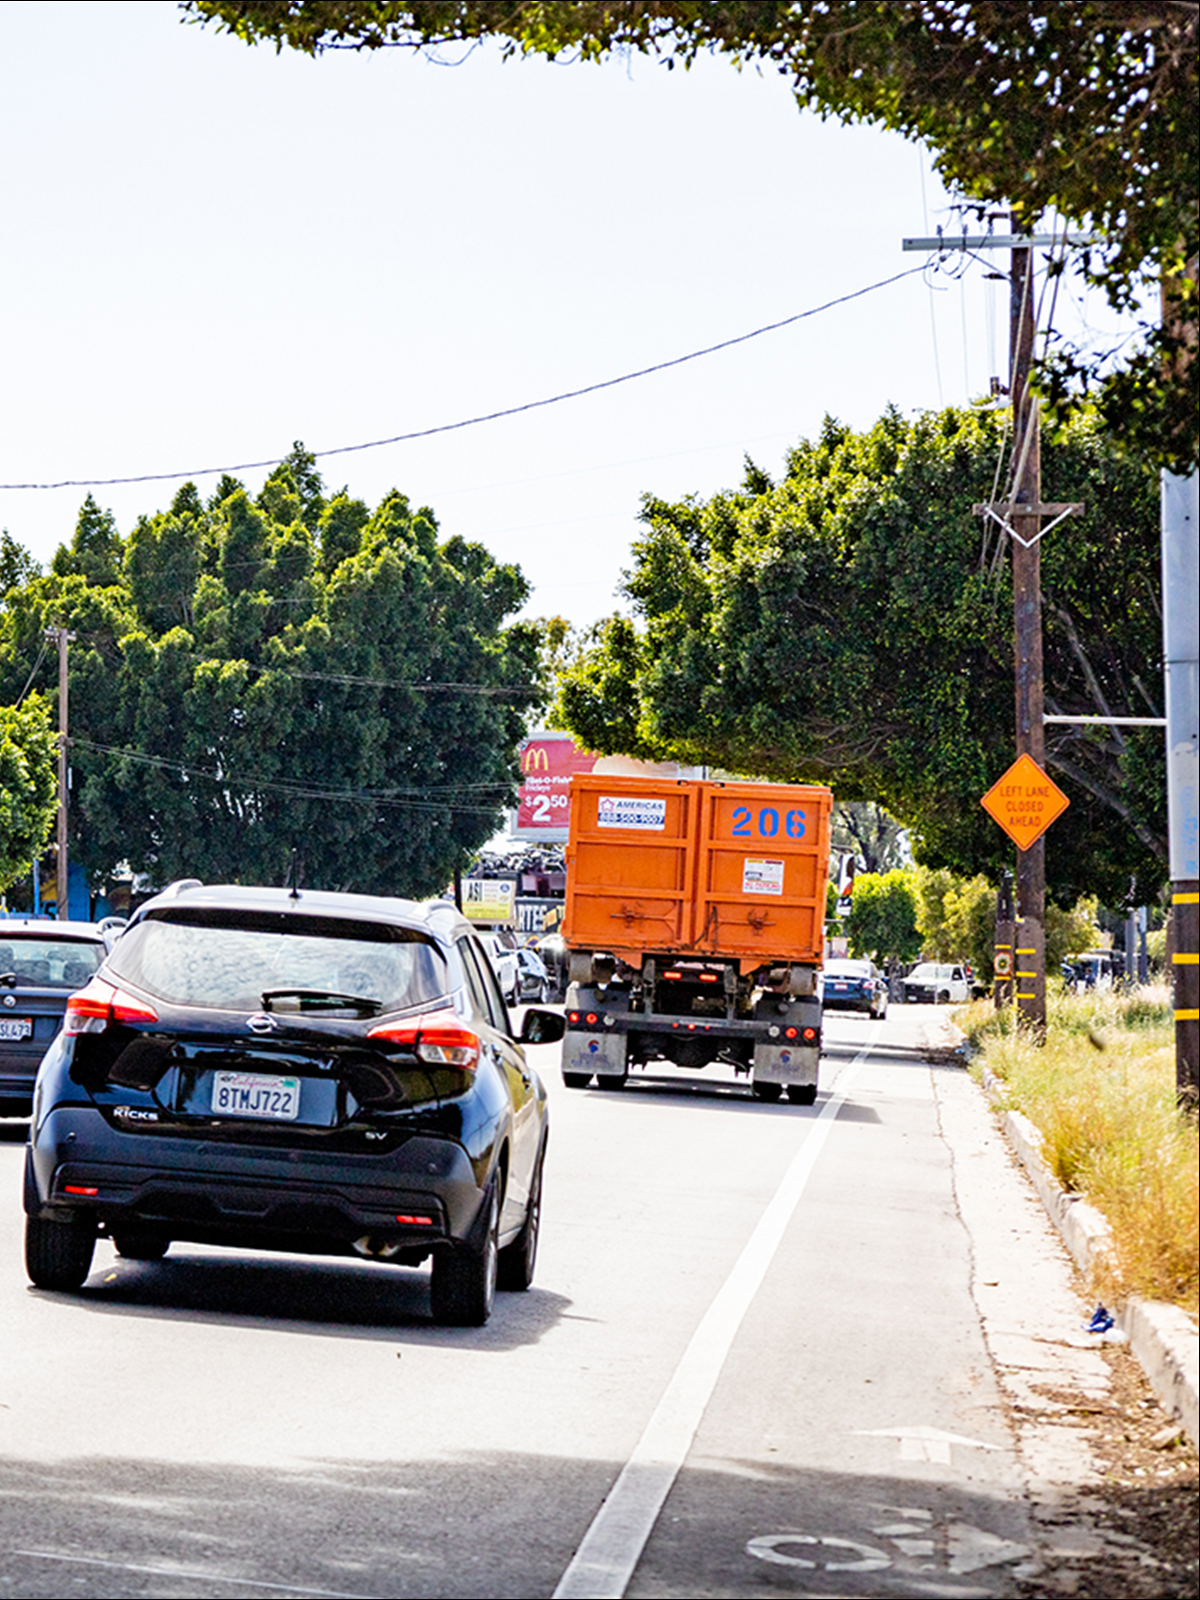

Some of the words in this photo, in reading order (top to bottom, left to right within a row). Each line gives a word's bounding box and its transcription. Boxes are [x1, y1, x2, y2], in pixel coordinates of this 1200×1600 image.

[1000, 786, 1022, 797] LEFT
[1025, 786, 1049, 798] LANE
[616, 801, 663, 810] AMERICAS
[1006, 801, 1044, 813] CLOSED
[731, 806, 806, 839] 206
[1008, 816, 1042, 827] AHEAD
[218, 1087, 292, 1113] 8TMJ722
[113, 1108, 159, 1120] KICKS
